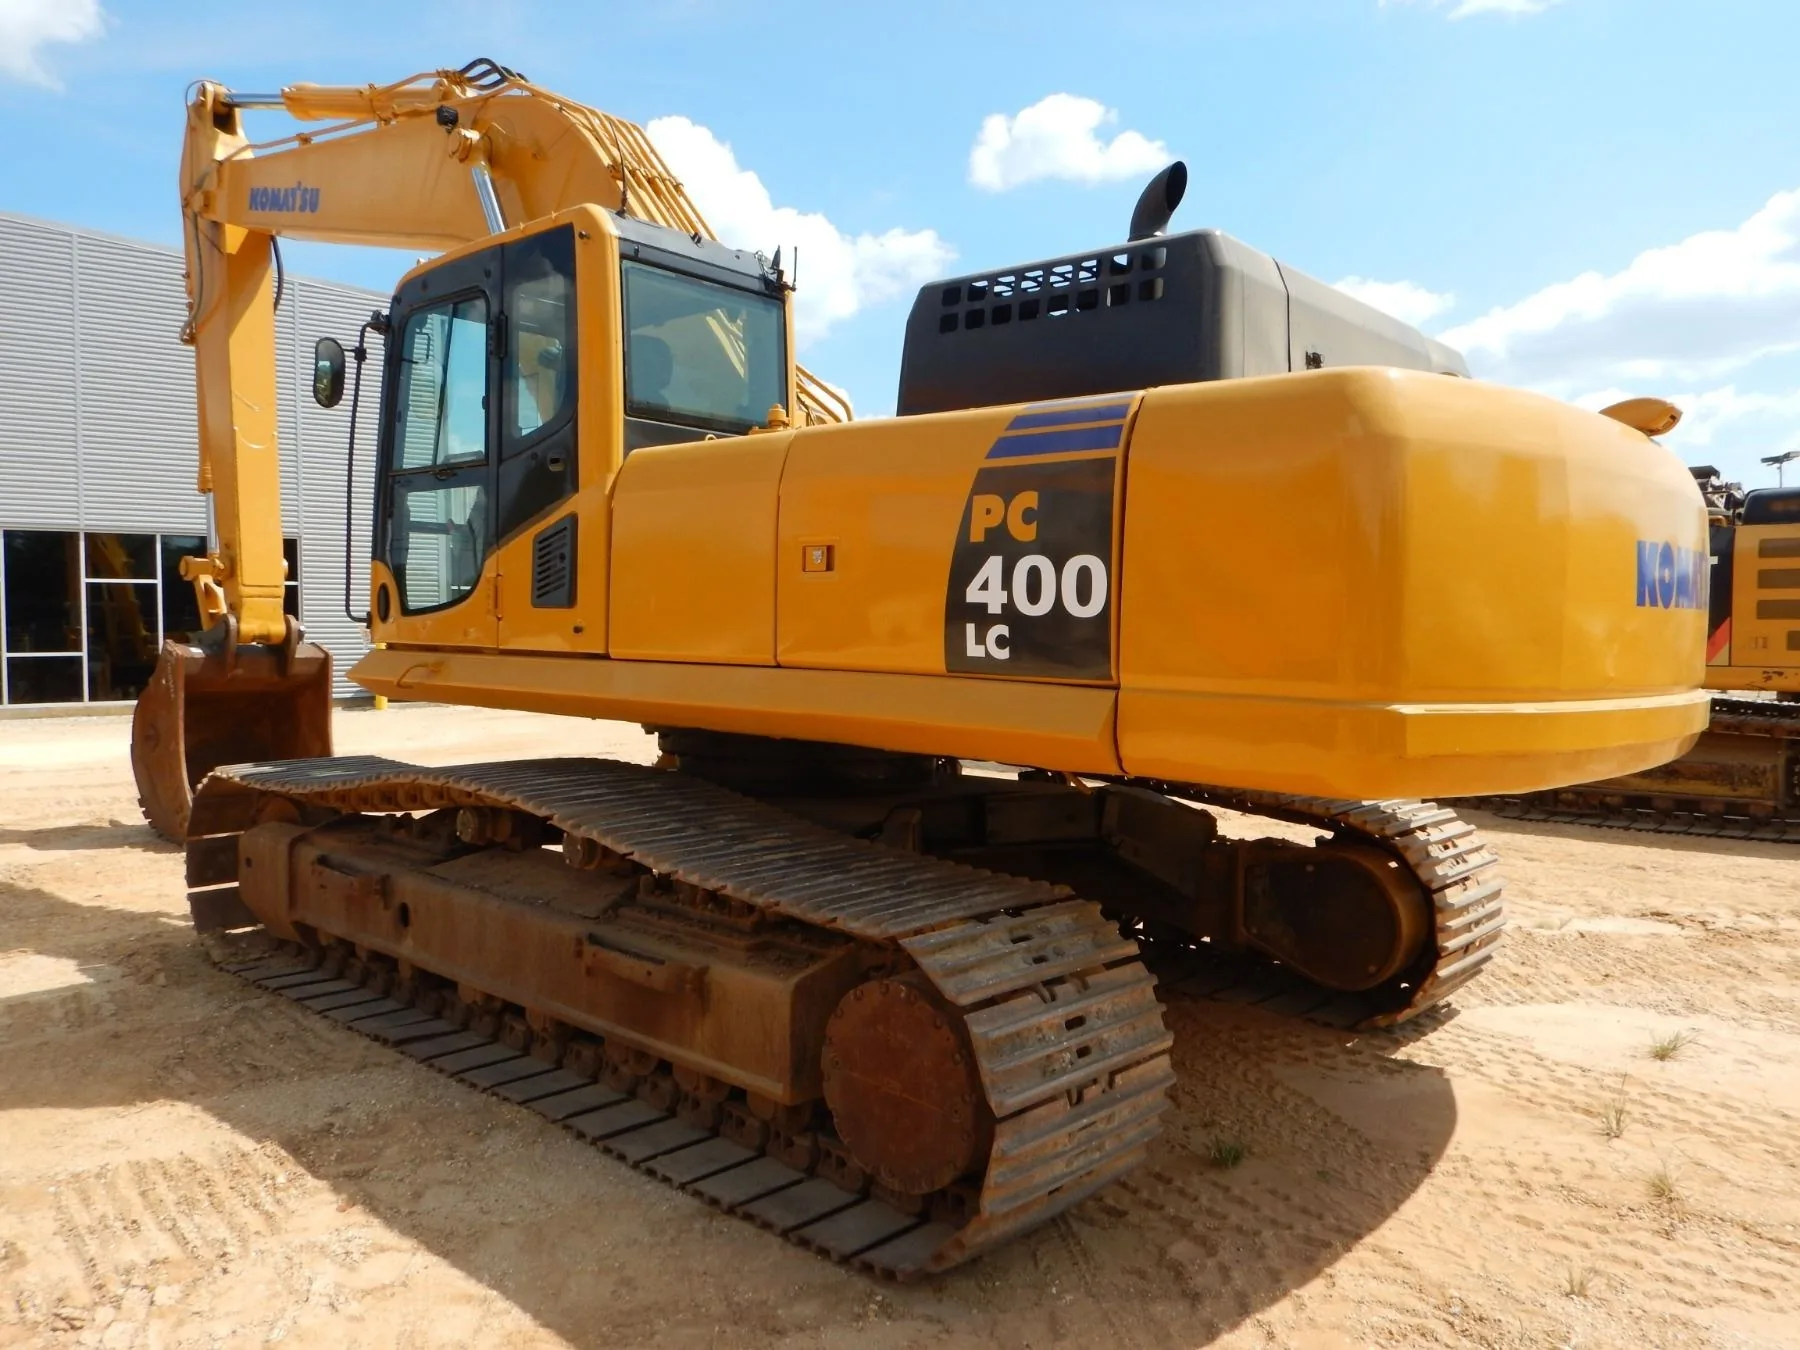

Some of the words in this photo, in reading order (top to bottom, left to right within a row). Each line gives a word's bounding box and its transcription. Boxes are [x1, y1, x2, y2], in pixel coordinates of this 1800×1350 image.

[249, 181, 320, 213] KOMATSU
[969, 491, 1038, 542] PC
[966, 554, 1107, 617] 400
[966, 623, 1010, 659] LC
